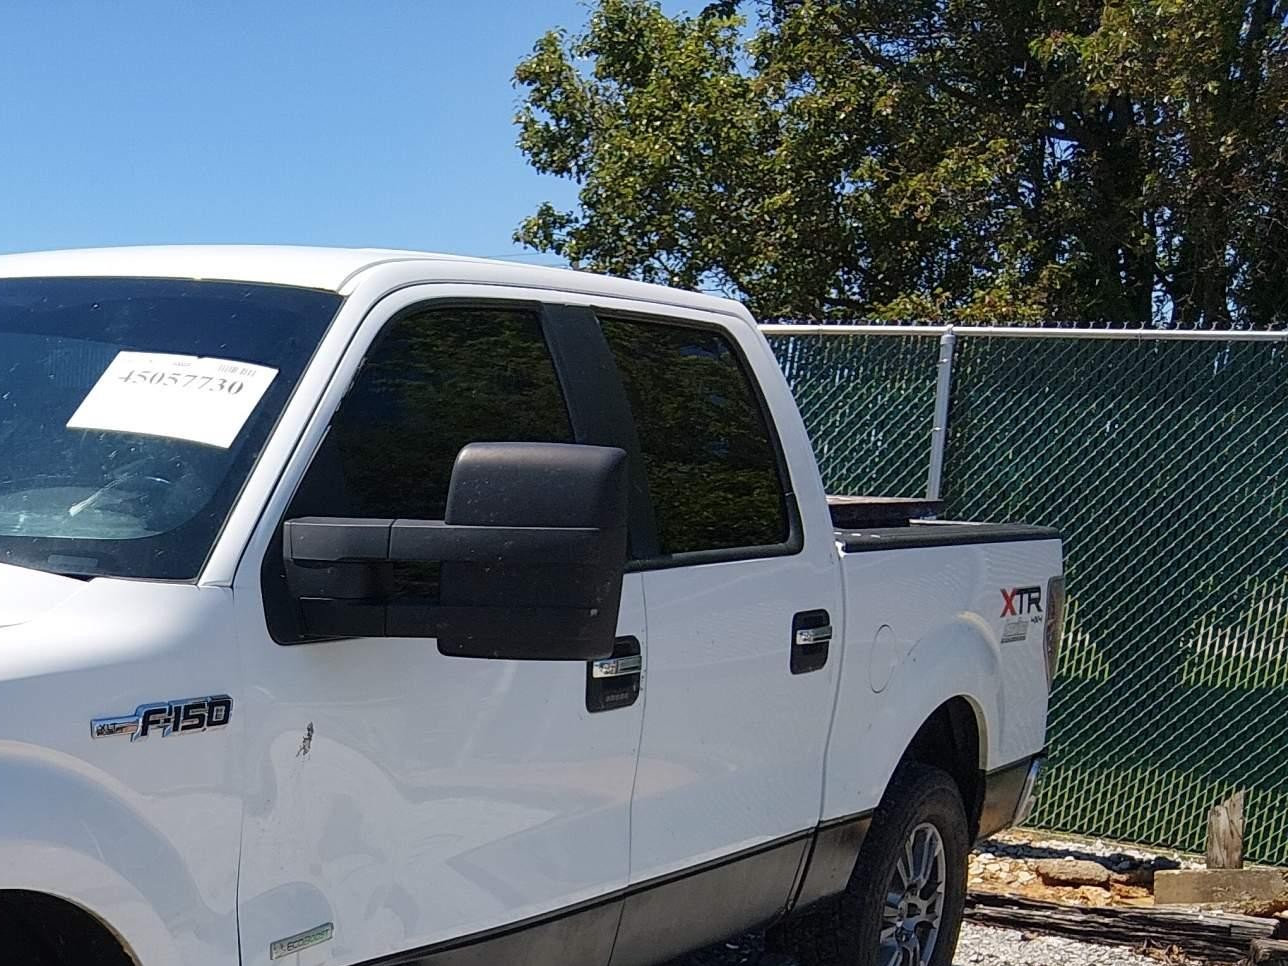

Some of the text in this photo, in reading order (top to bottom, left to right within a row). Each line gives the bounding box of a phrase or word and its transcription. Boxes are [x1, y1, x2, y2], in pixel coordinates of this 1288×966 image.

[118, 368, 245, 396] 45057730
[999, 585, 1043, 618] XTR
[139, 697, 233, 738] F-150
